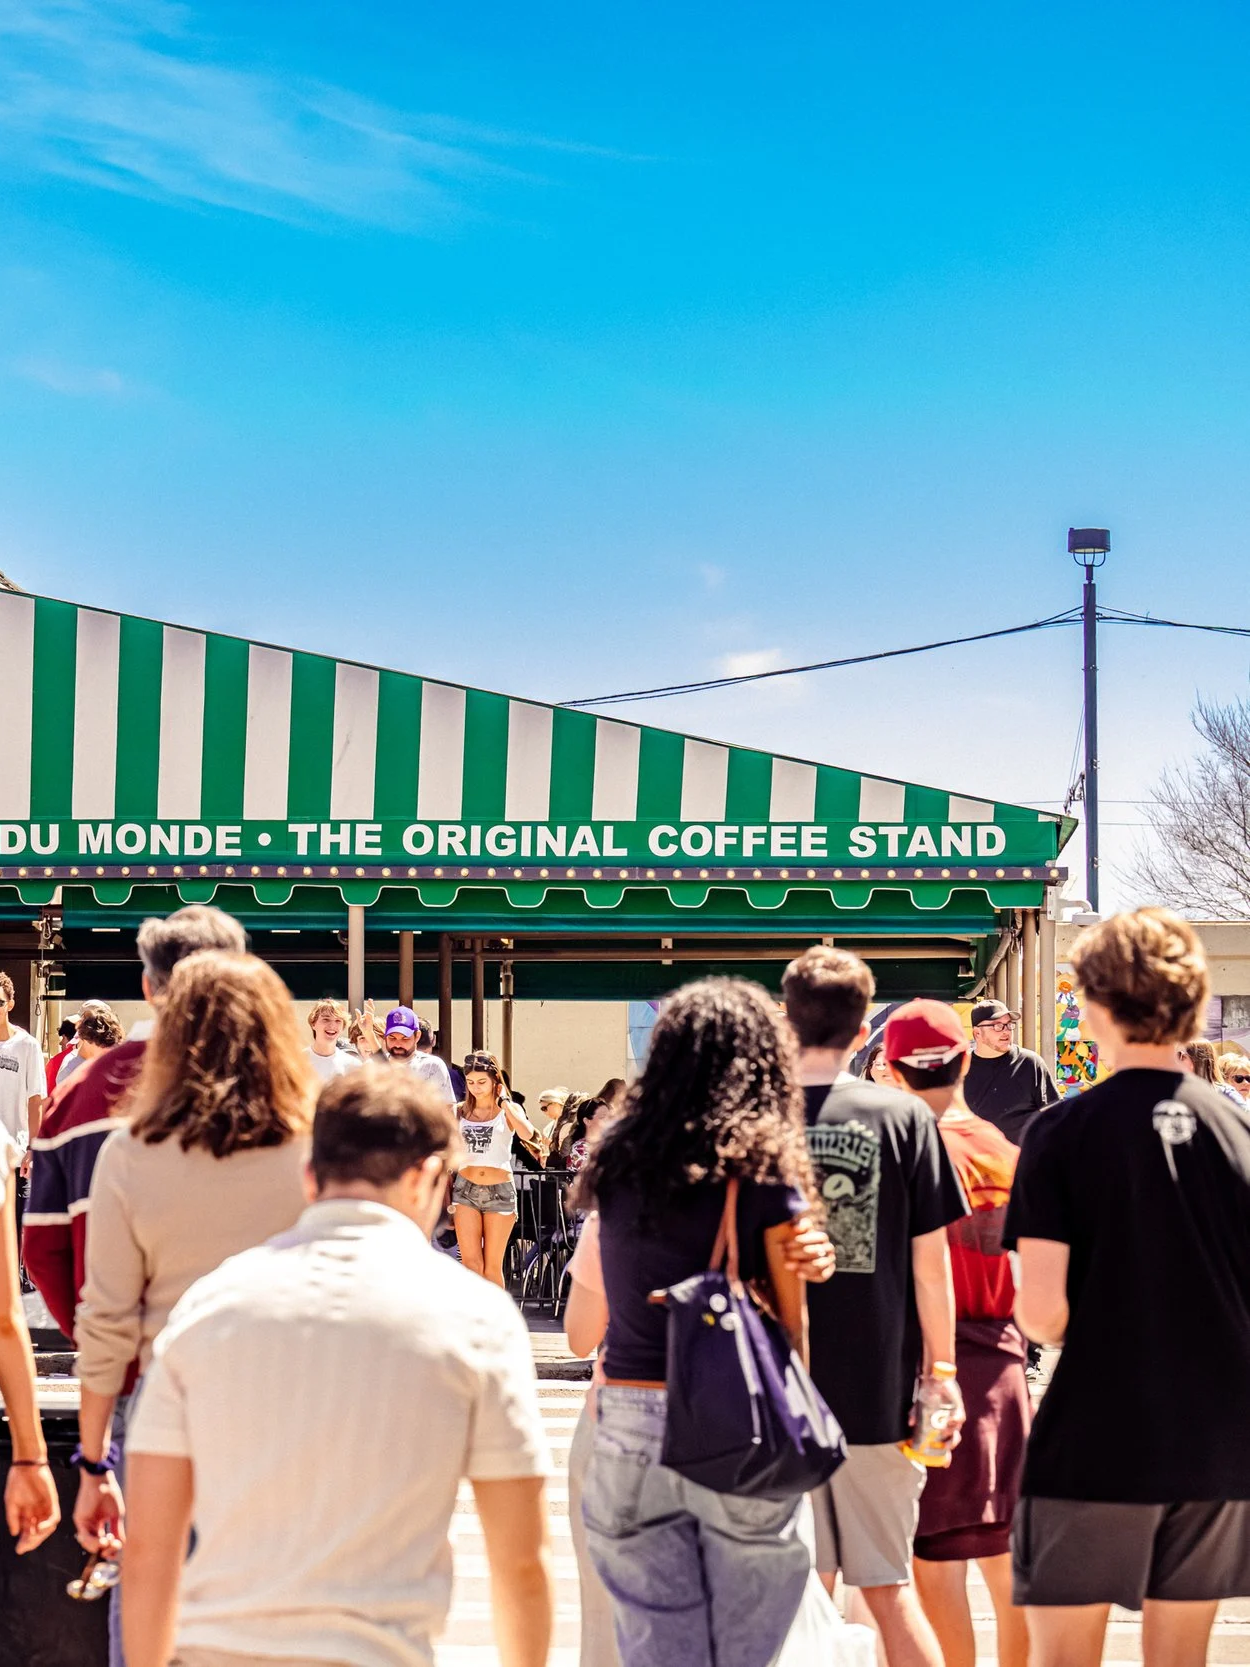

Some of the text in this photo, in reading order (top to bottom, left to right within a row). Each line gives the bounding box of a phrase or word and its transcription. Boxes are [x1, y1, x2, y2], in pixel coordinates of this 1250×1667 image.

[78, 823, 242, 856] MONDE
[288, 824, 382, 856] THE
[402, 824, 628, 857] ORIGINAL
[648, 825, 828, 857] COFFEE
[848, 826, 1006, 858] STAND
